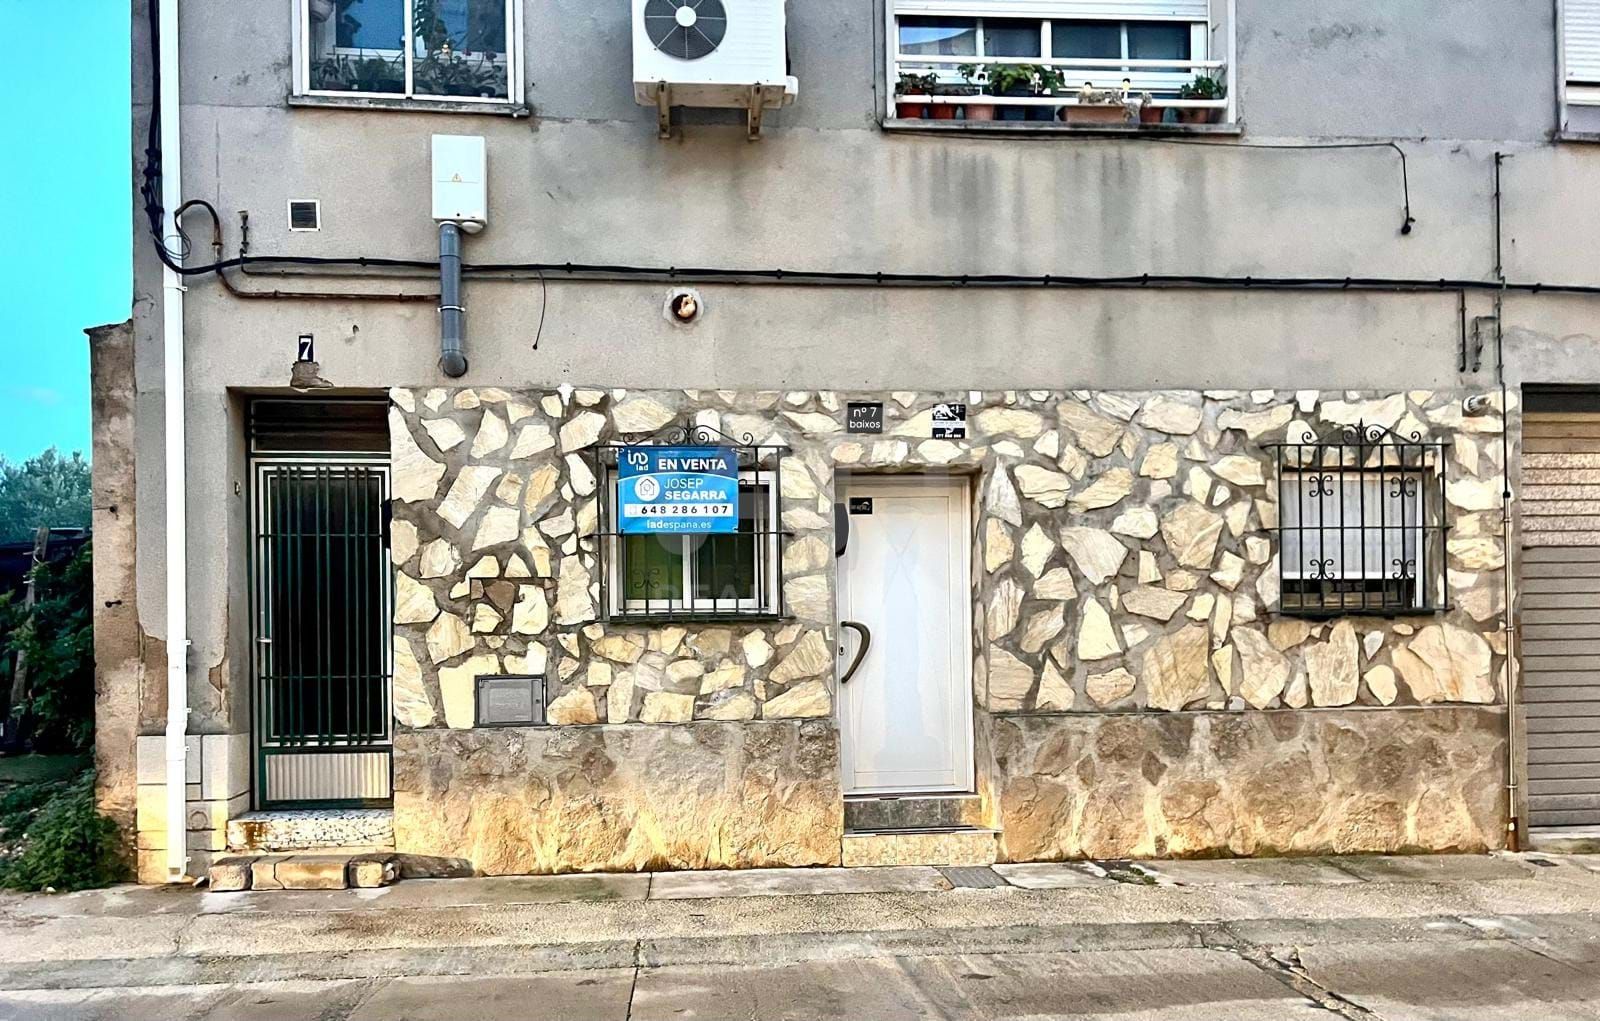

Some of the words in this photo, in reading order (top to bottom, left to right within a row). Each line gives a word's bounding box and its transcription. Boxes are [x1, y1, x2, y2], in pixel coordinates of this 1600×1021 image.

[300, 338, 312, 360] 7
[870, 407, 877, 417] 7
[849, 420, 881, 429] baixos
[658, 459, 677, 470] EN
[680, 459, 727, 470] VENTA
[664, 478, 704, 489] JOSEP
[664, 491, 727, 500] SEGARRA
[641, 506, 667, 514] 648
[672, 506, 698, 514] 286
[704, 506, 728, 514] 107
